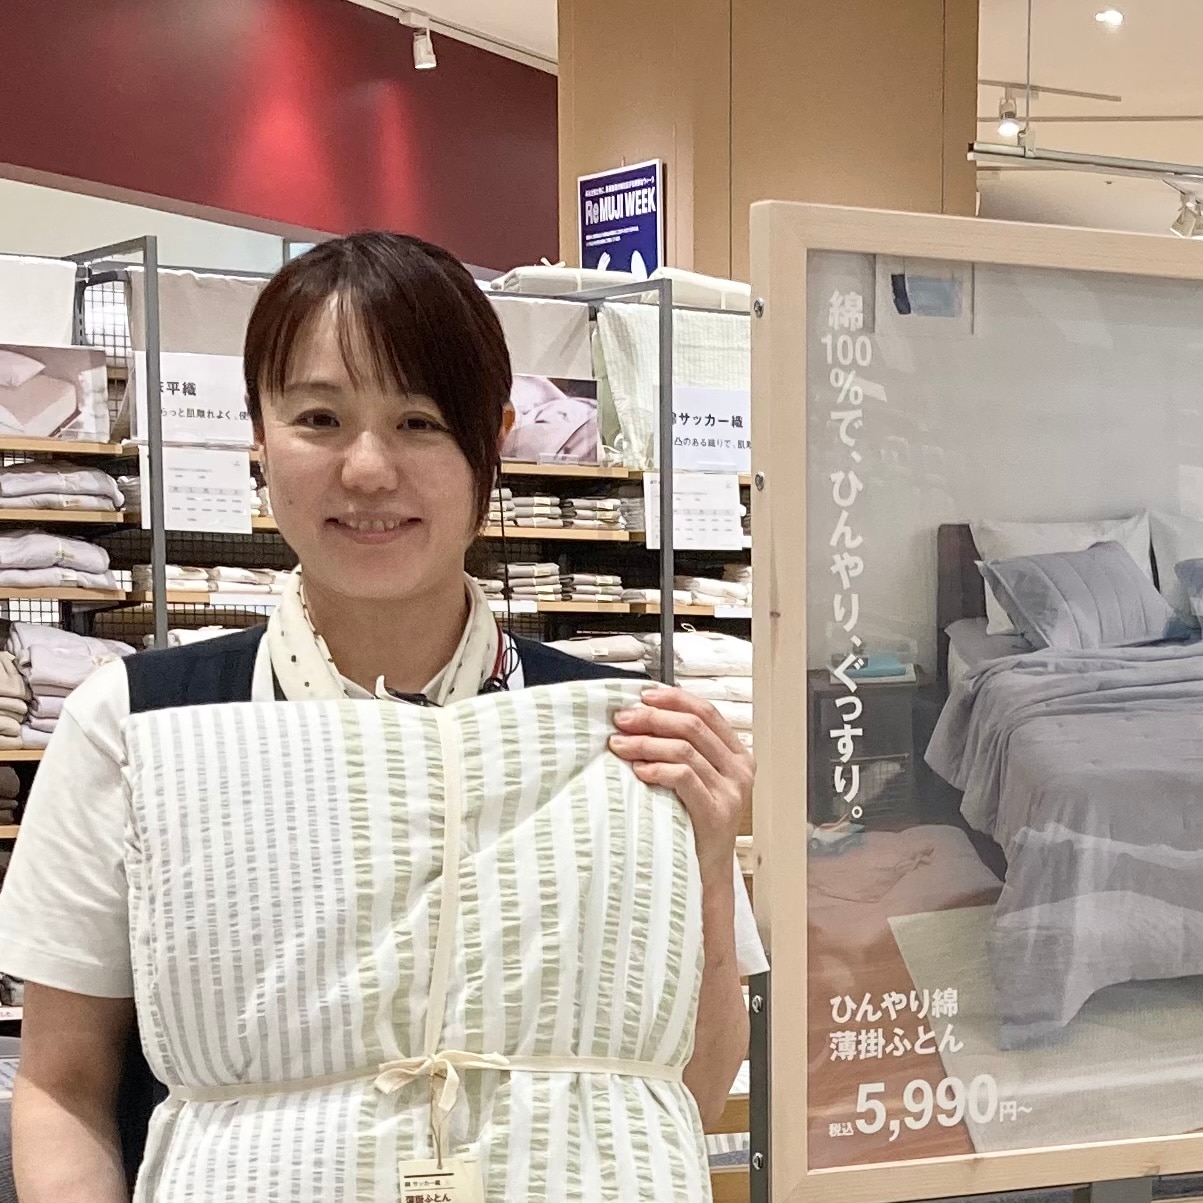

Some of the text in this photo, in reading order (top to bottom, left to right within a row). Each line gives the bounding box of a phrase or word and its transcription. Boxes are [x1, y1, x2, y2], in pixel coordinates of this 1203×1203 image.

[624, 187, 656, 217] WEEK
[821, 289, 872, 819] 綿100%で、ひんやり、ぐっすり。
[830, 988, 958, 1023] ひんやり綿
[830, 1024, 964, 1061] 薄掛ふとん
